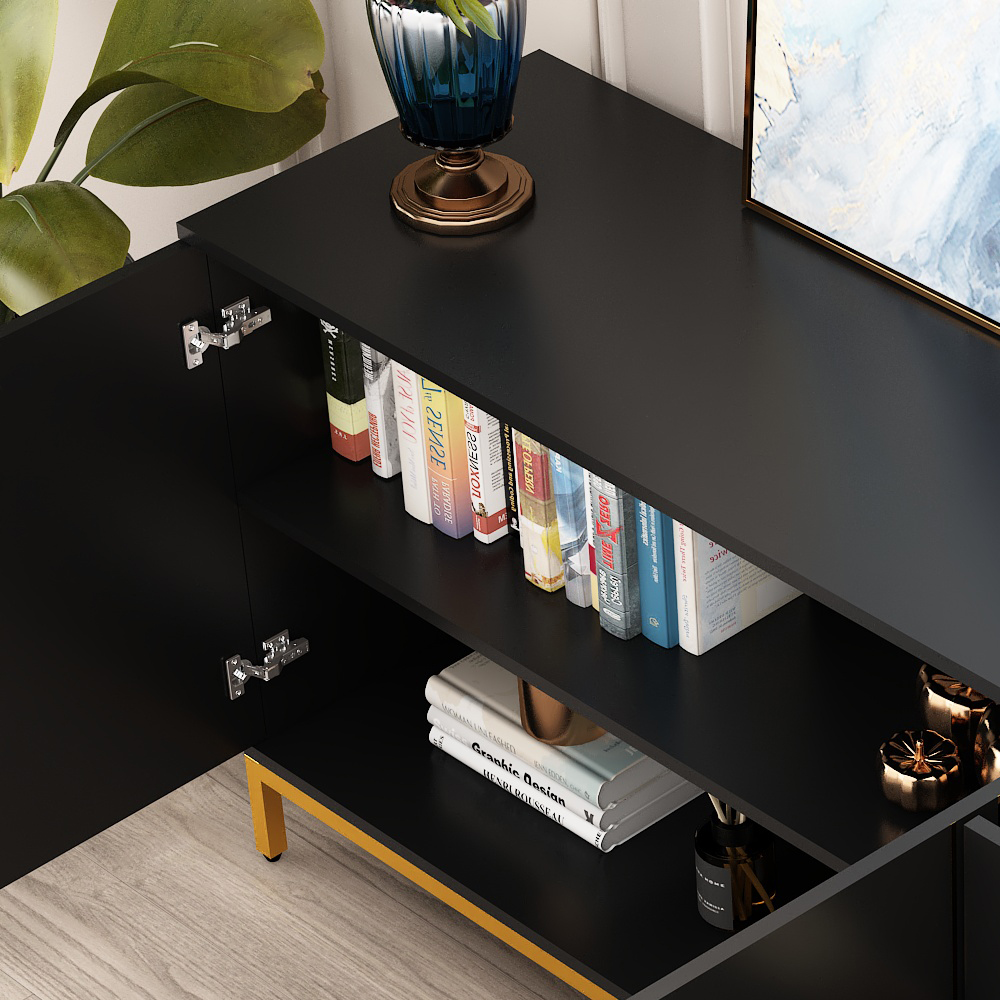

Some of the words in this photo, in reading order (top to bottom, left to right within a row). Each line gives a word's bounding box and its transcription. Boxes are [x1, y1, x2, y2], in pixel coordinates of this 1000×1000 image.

[441, 703, 473, 728] WOMAN
[473, 725, 517, 755] UNLEASHED
[471, 742, 520, 780] Graphic
[523, 772, 566, 807] Design
[483, 769, 512, 793] HENRI
[514, 787, 565, 825] ROUSSEAU
